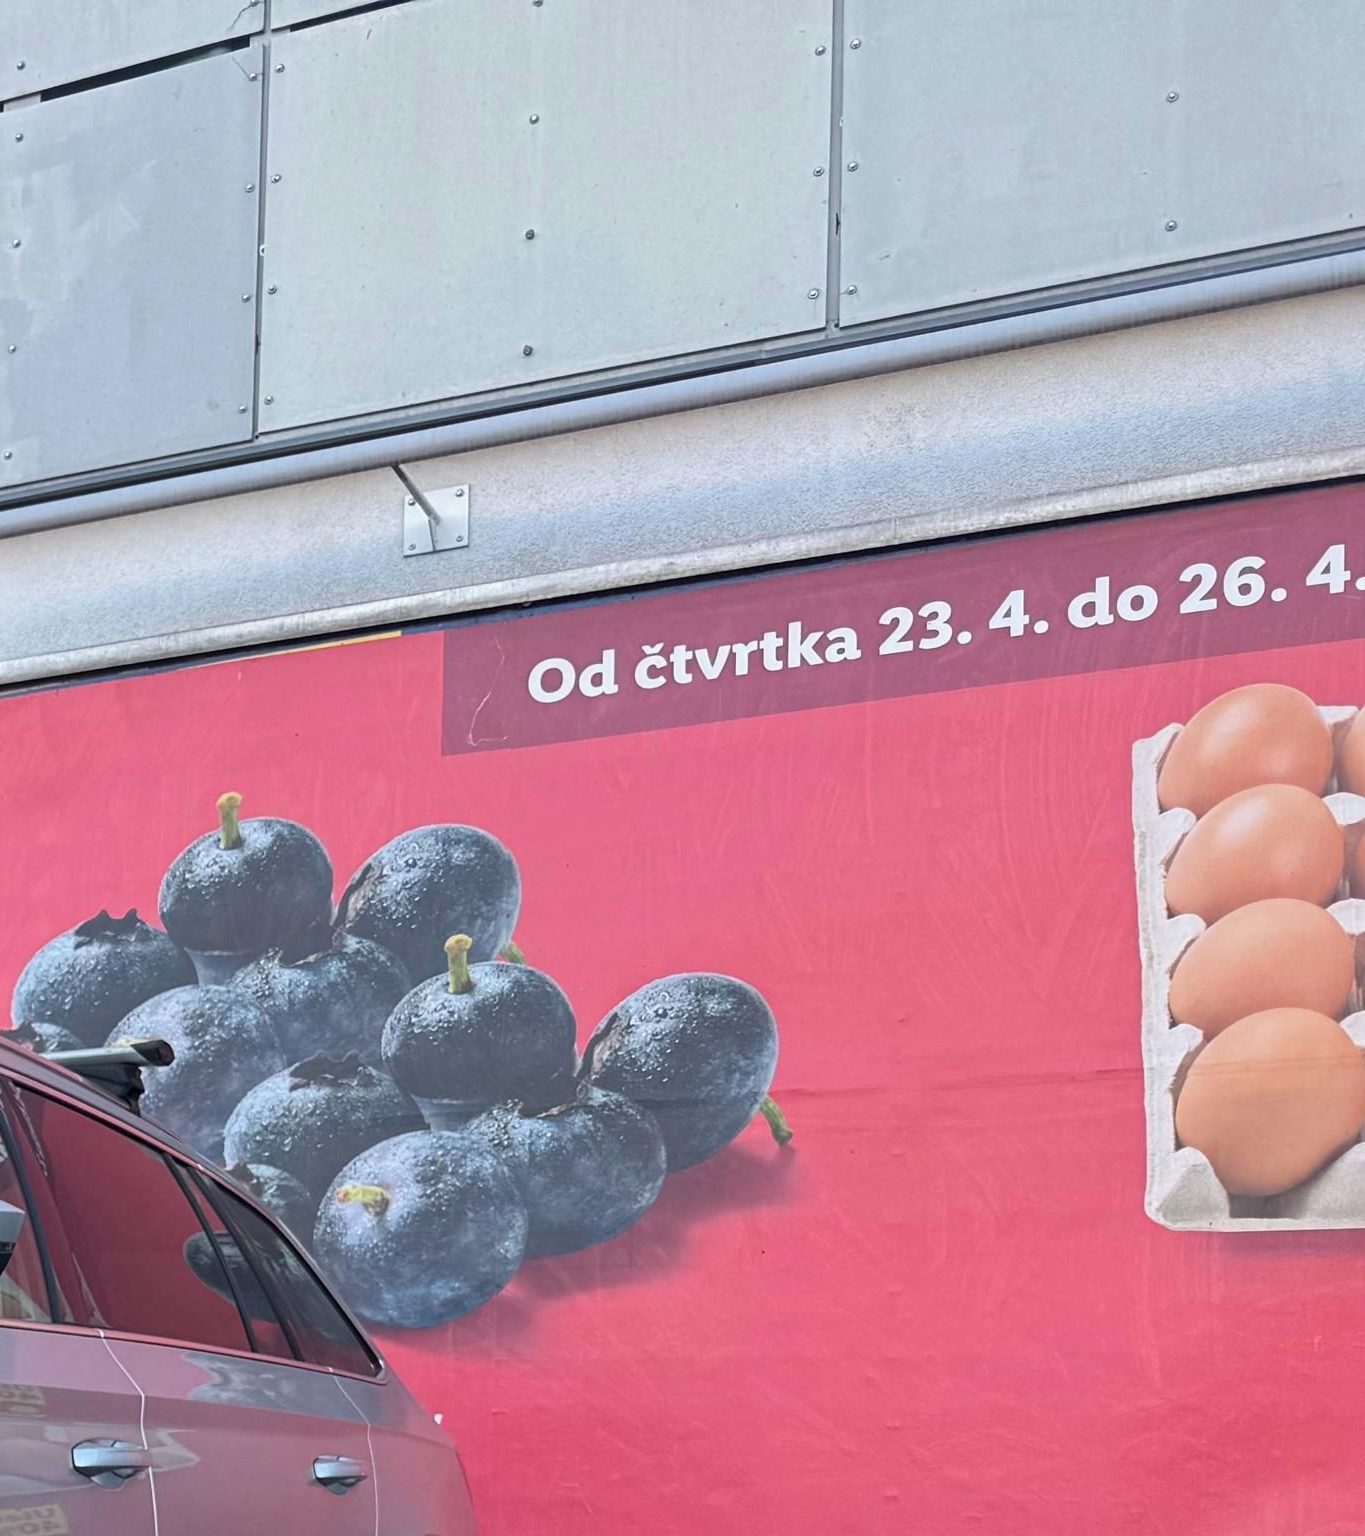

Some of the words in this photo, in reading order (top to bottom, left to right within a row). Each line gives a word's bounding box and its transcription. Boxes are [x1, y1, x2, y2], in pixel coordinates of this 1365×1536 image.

[528, 648, 618, 703] Od
[633, 621, 862, 689] čtvrtka
[878, 600, 972, 655] 23.
[988, 589, 1049, 637] 4.
[1067, 576, 1159, 628] do
[1179, 556, 1287, 614] 26.
[1305, 543, 1365, 594] 4.
